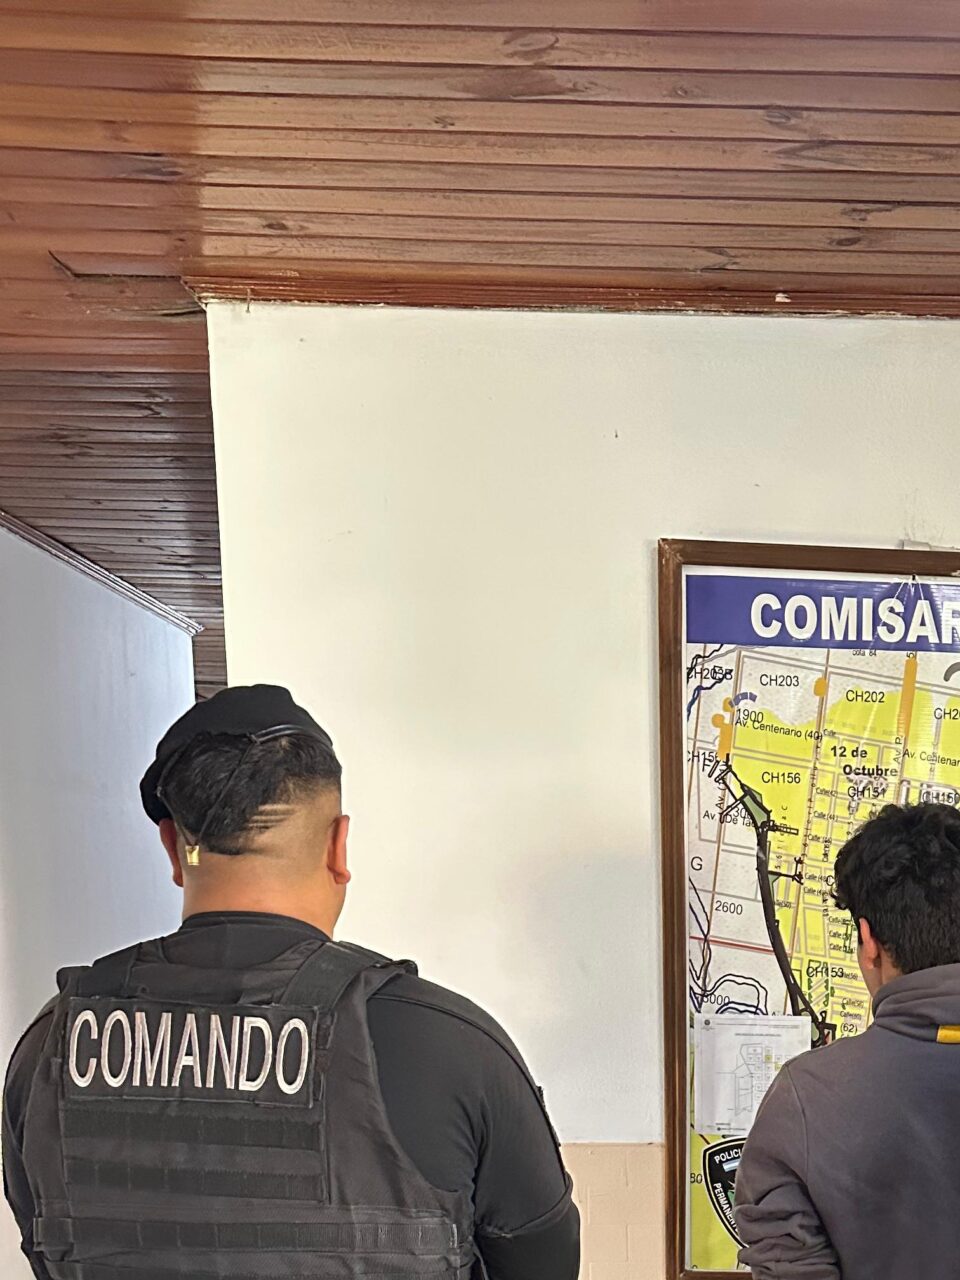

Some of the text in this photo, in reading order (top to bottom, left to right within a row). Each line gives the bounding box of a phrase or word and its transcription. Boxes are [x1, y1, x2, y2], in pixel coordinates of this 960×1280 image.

[759, 673, 800, 687] CH203
[845, 689, 885, 703] CH202
[736, 708, 764, 723] 1900
[752, 719, 802, 738] Centenario
[687, 749, 718, 763] H15
[830, 745, 868, 759] 12 de
[842, 763, 898, 777] Octubre
[761, 771, 801, 784] CH156
[690, 857, 703, 871] G
[714, 900, 743, 915] 2600
[840, 1023, 858, 1034] (62)
[68, 1009, 309, 1095] COMANDO
[713, 1182, 740, 1234] PERMANE
